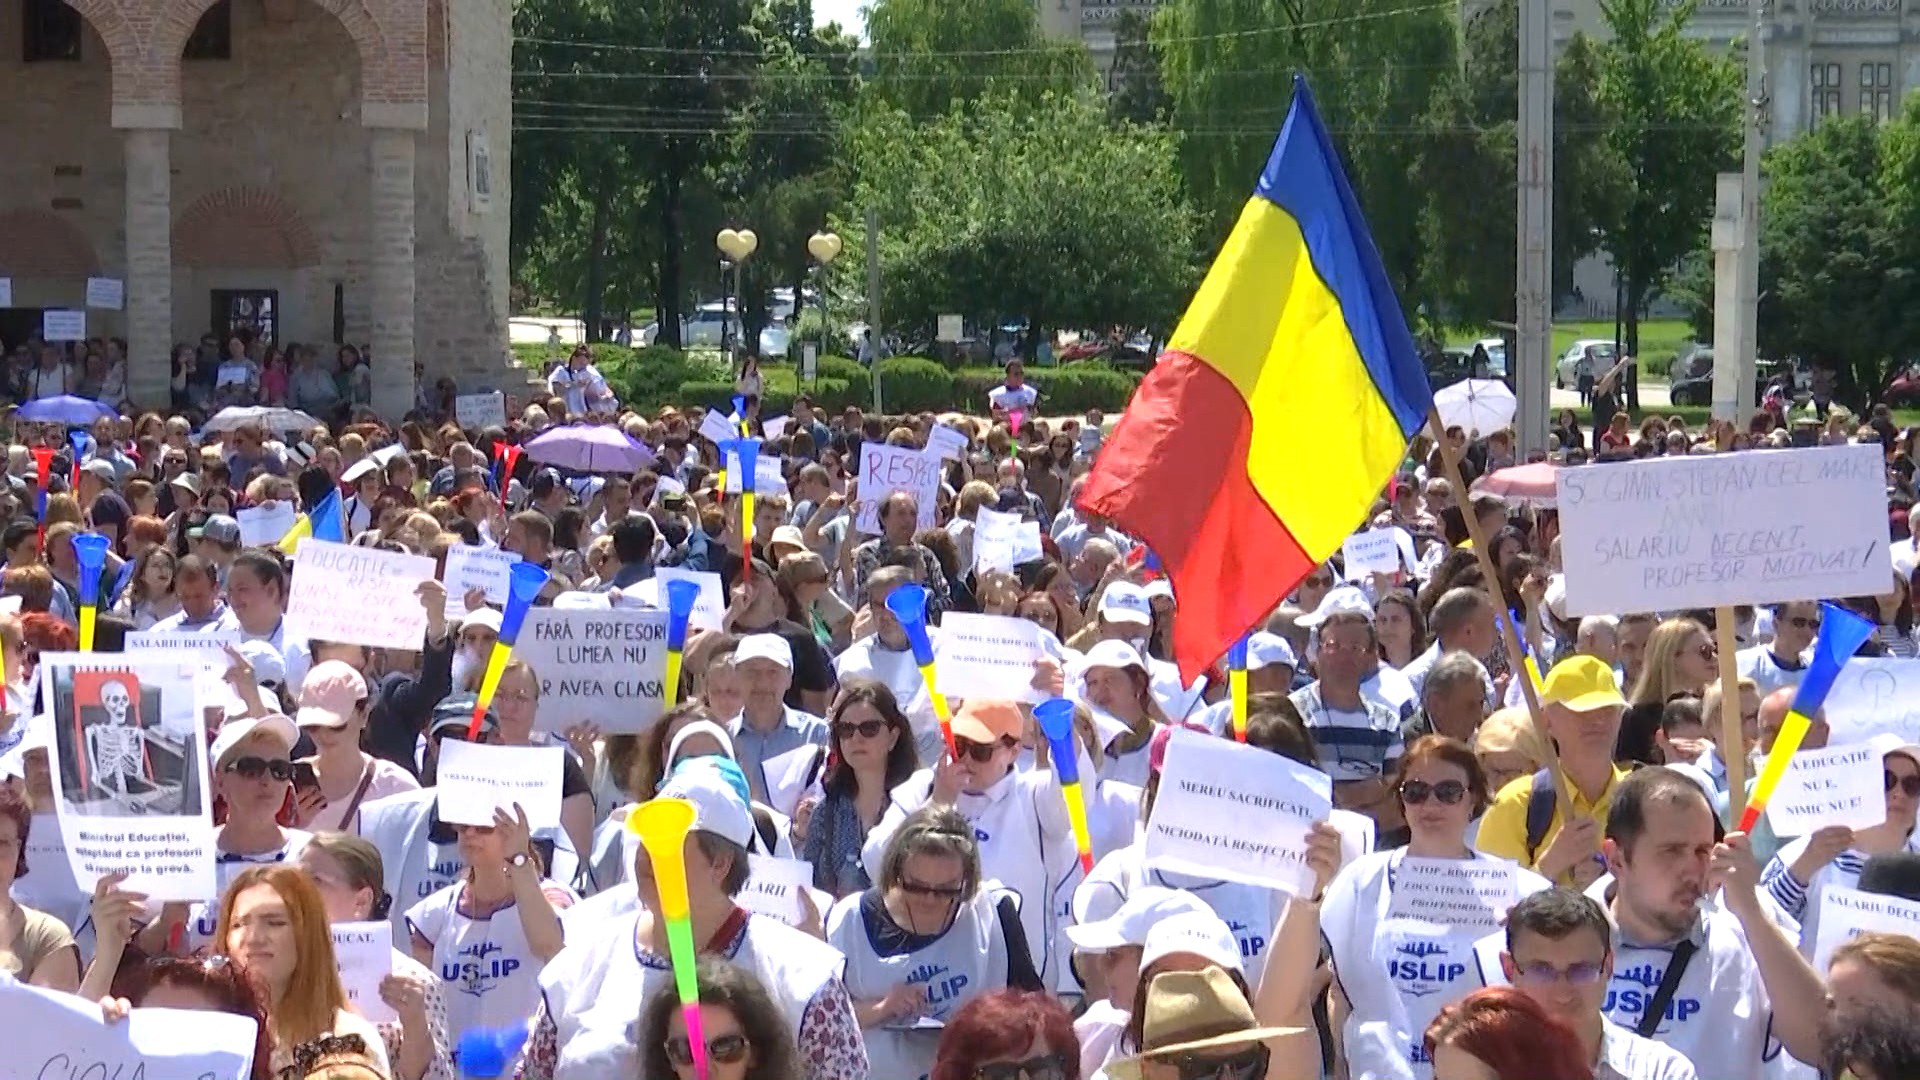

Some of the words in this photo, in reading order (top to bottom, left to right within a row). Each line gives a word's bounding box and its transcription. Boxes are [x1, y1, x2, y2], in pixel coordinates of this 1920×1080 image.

[1594, 535, 1691, 566] SALARIU
[1642, 562, 1746, 590] PROFESOR
[585, 621, 666, 640] PROFESORI
[556, 645, 615, 664] LUMEA
[624, 646, 647, 664] NU
[559, 679, 604, 697] AVEA
[1178, 779, 1227, 799] MEREU
[1803, 780, 1821, 792] NU
[1786, 803, 1824, 816] NIMIC
[1829, 799, 1847, 811] NU
[1887, 905, 1920, 922] DECE
[927, 974, 968, 1005] LIP
